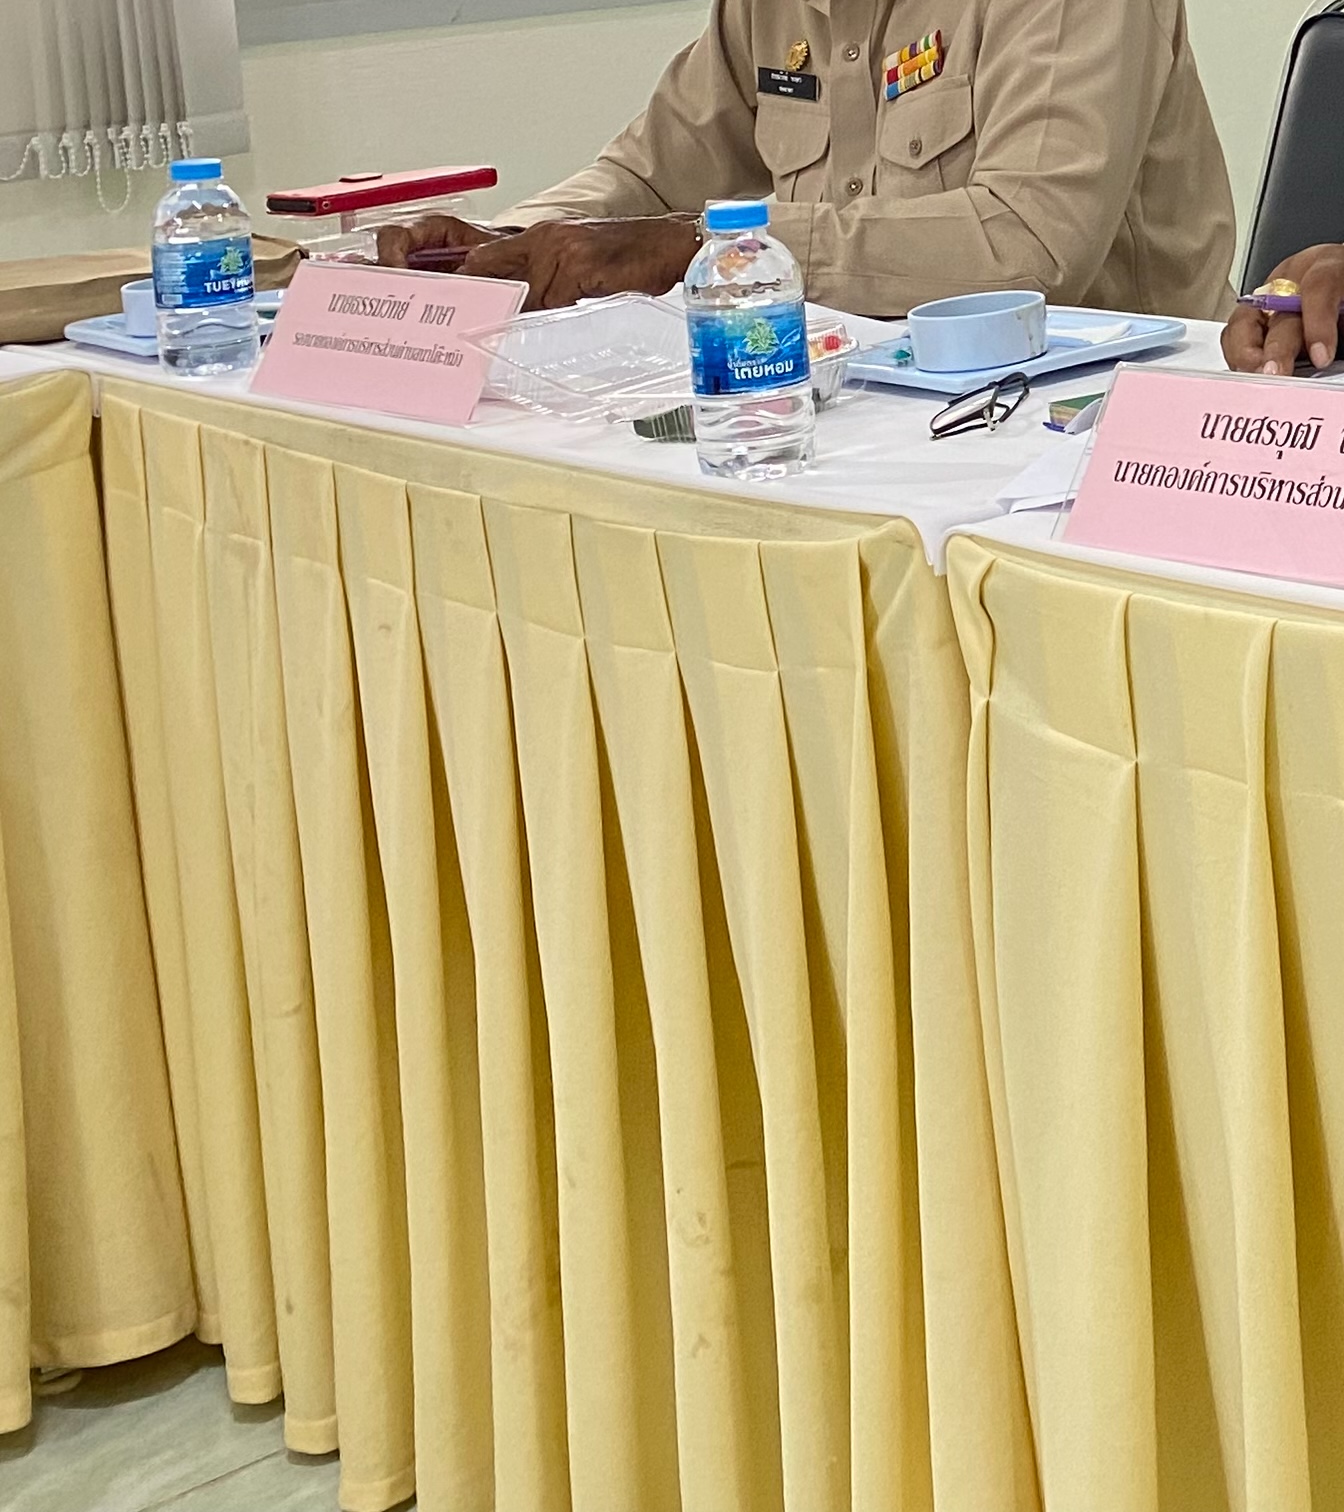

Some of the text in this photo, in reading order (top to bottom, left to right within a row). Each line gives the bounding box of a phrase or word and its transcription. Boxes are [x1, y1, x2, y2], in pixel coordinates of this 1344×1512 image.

[735, 359, 794, 380] เตยหอม
[1200, 412, 1325, 460] นายสรวุฒิ
